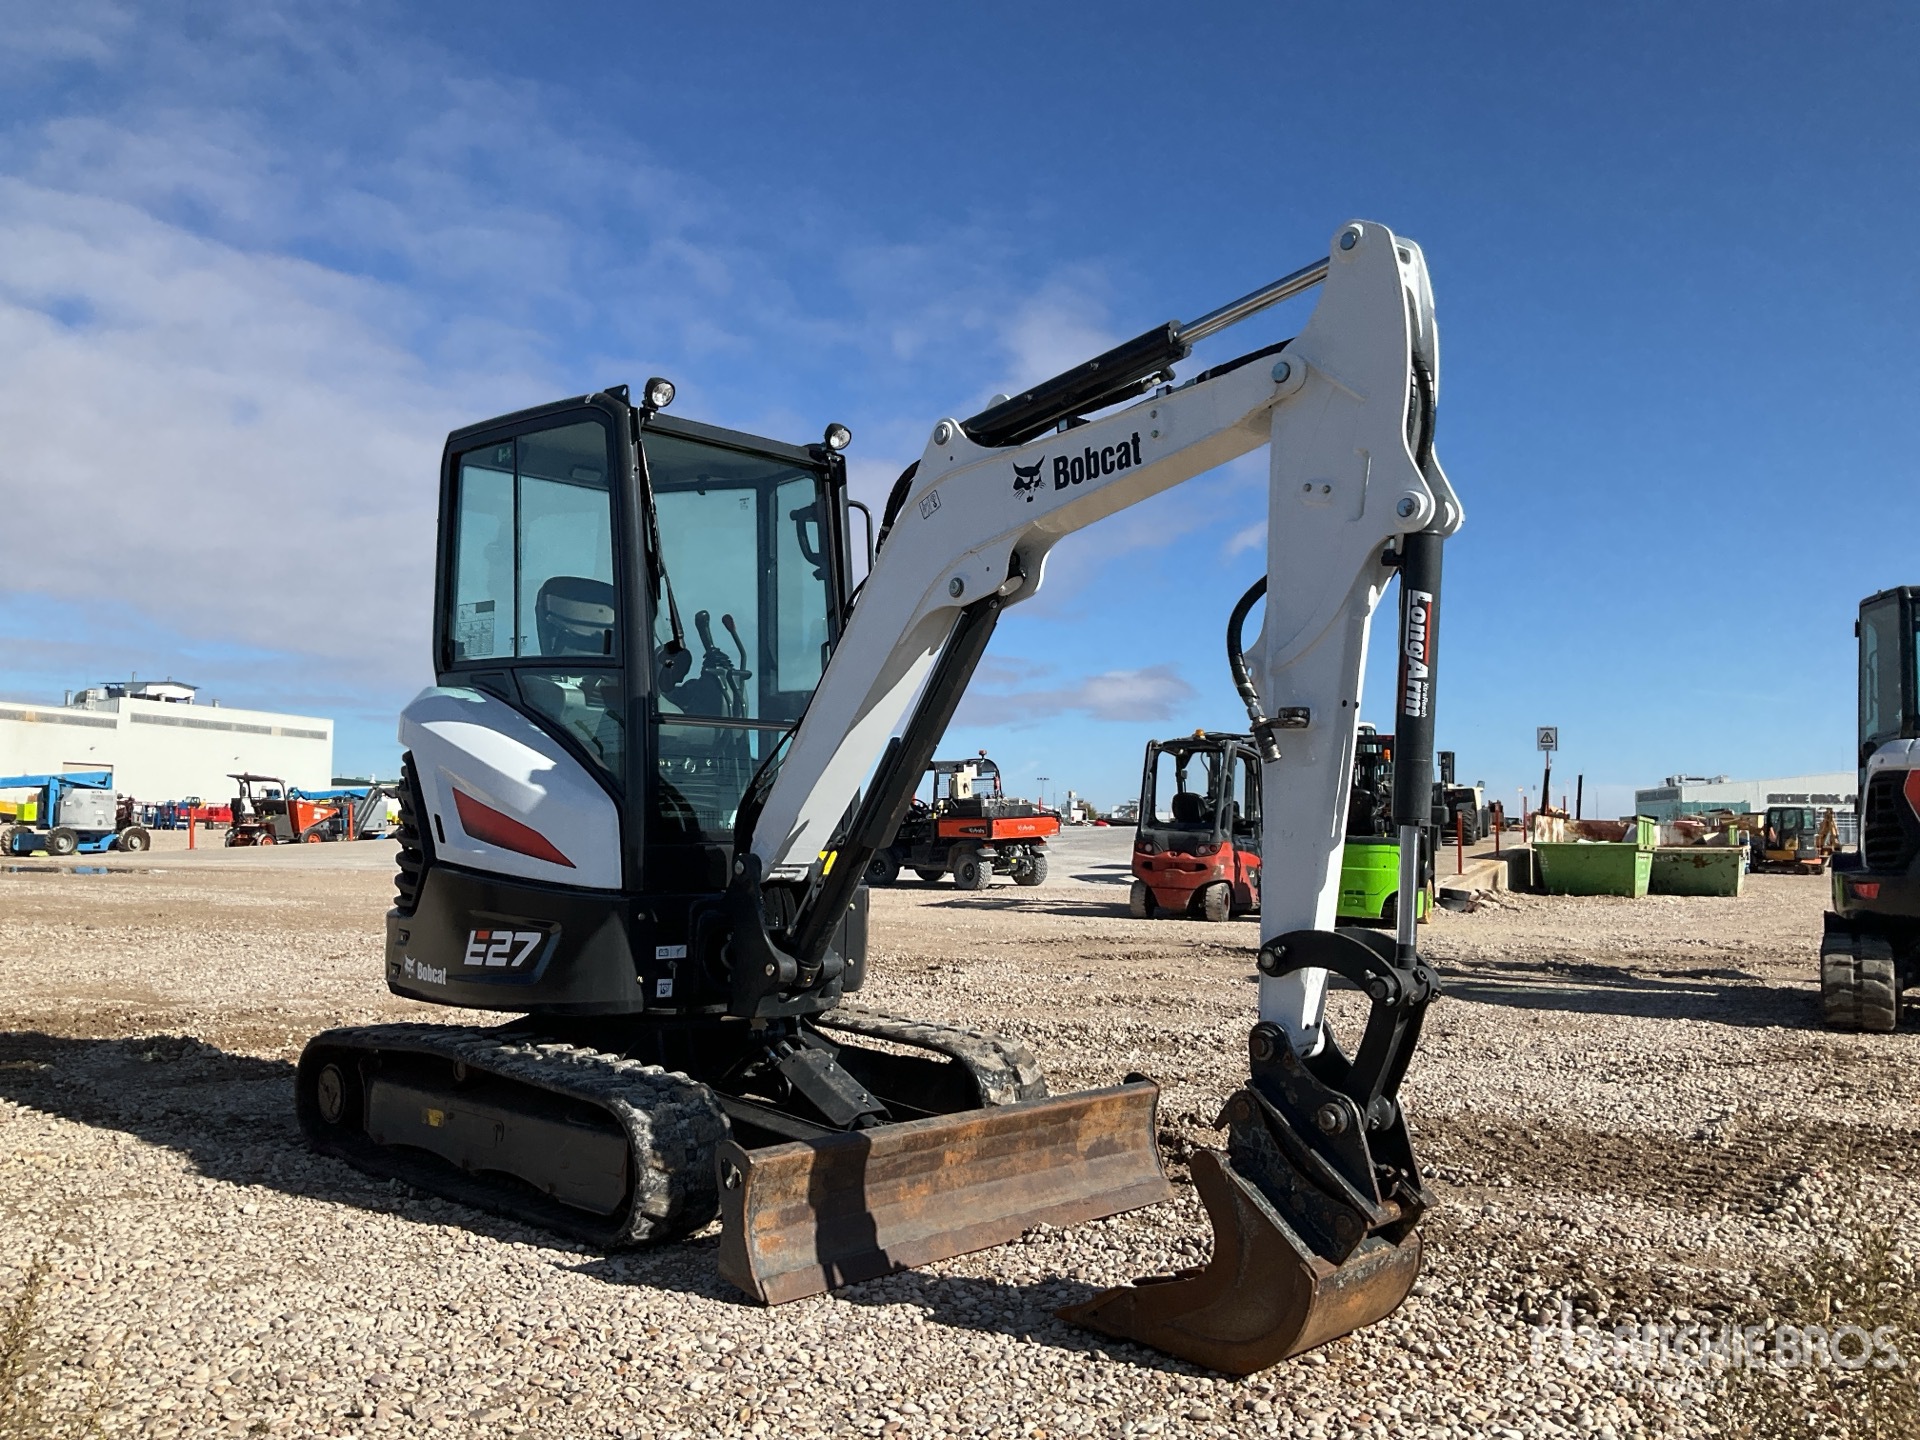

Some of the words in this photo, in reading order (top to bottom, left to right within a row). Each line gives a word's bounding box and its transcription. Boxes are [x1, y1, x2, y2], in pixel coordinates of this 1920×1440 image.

[1053, 432, 1142, 490] Bobcat
[1405, 589, 1432, 717] LongArm
[463, 929, 542, 967] E27
[417, 961, 447, 986] Bobcat
